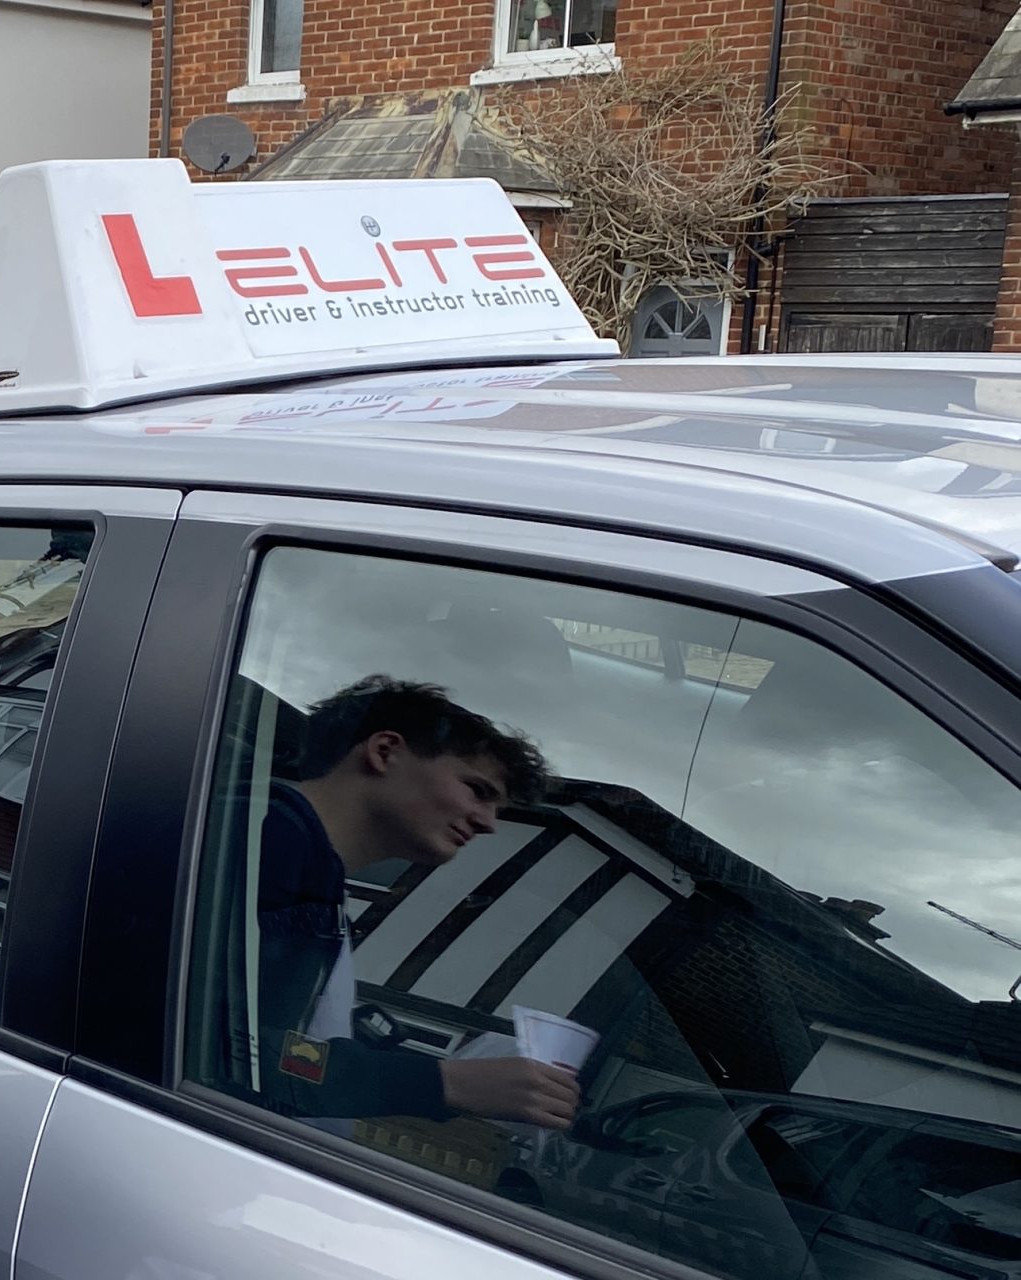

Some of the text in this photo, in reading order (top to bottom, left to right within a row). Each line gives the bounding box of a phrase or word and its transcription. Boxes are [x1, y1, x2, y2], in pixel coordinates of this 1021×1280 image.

[102, 214, 202, 317] L
[215, 234, 546, 298] ELITE
[244, 284, 561, 326] driver & instructor training
